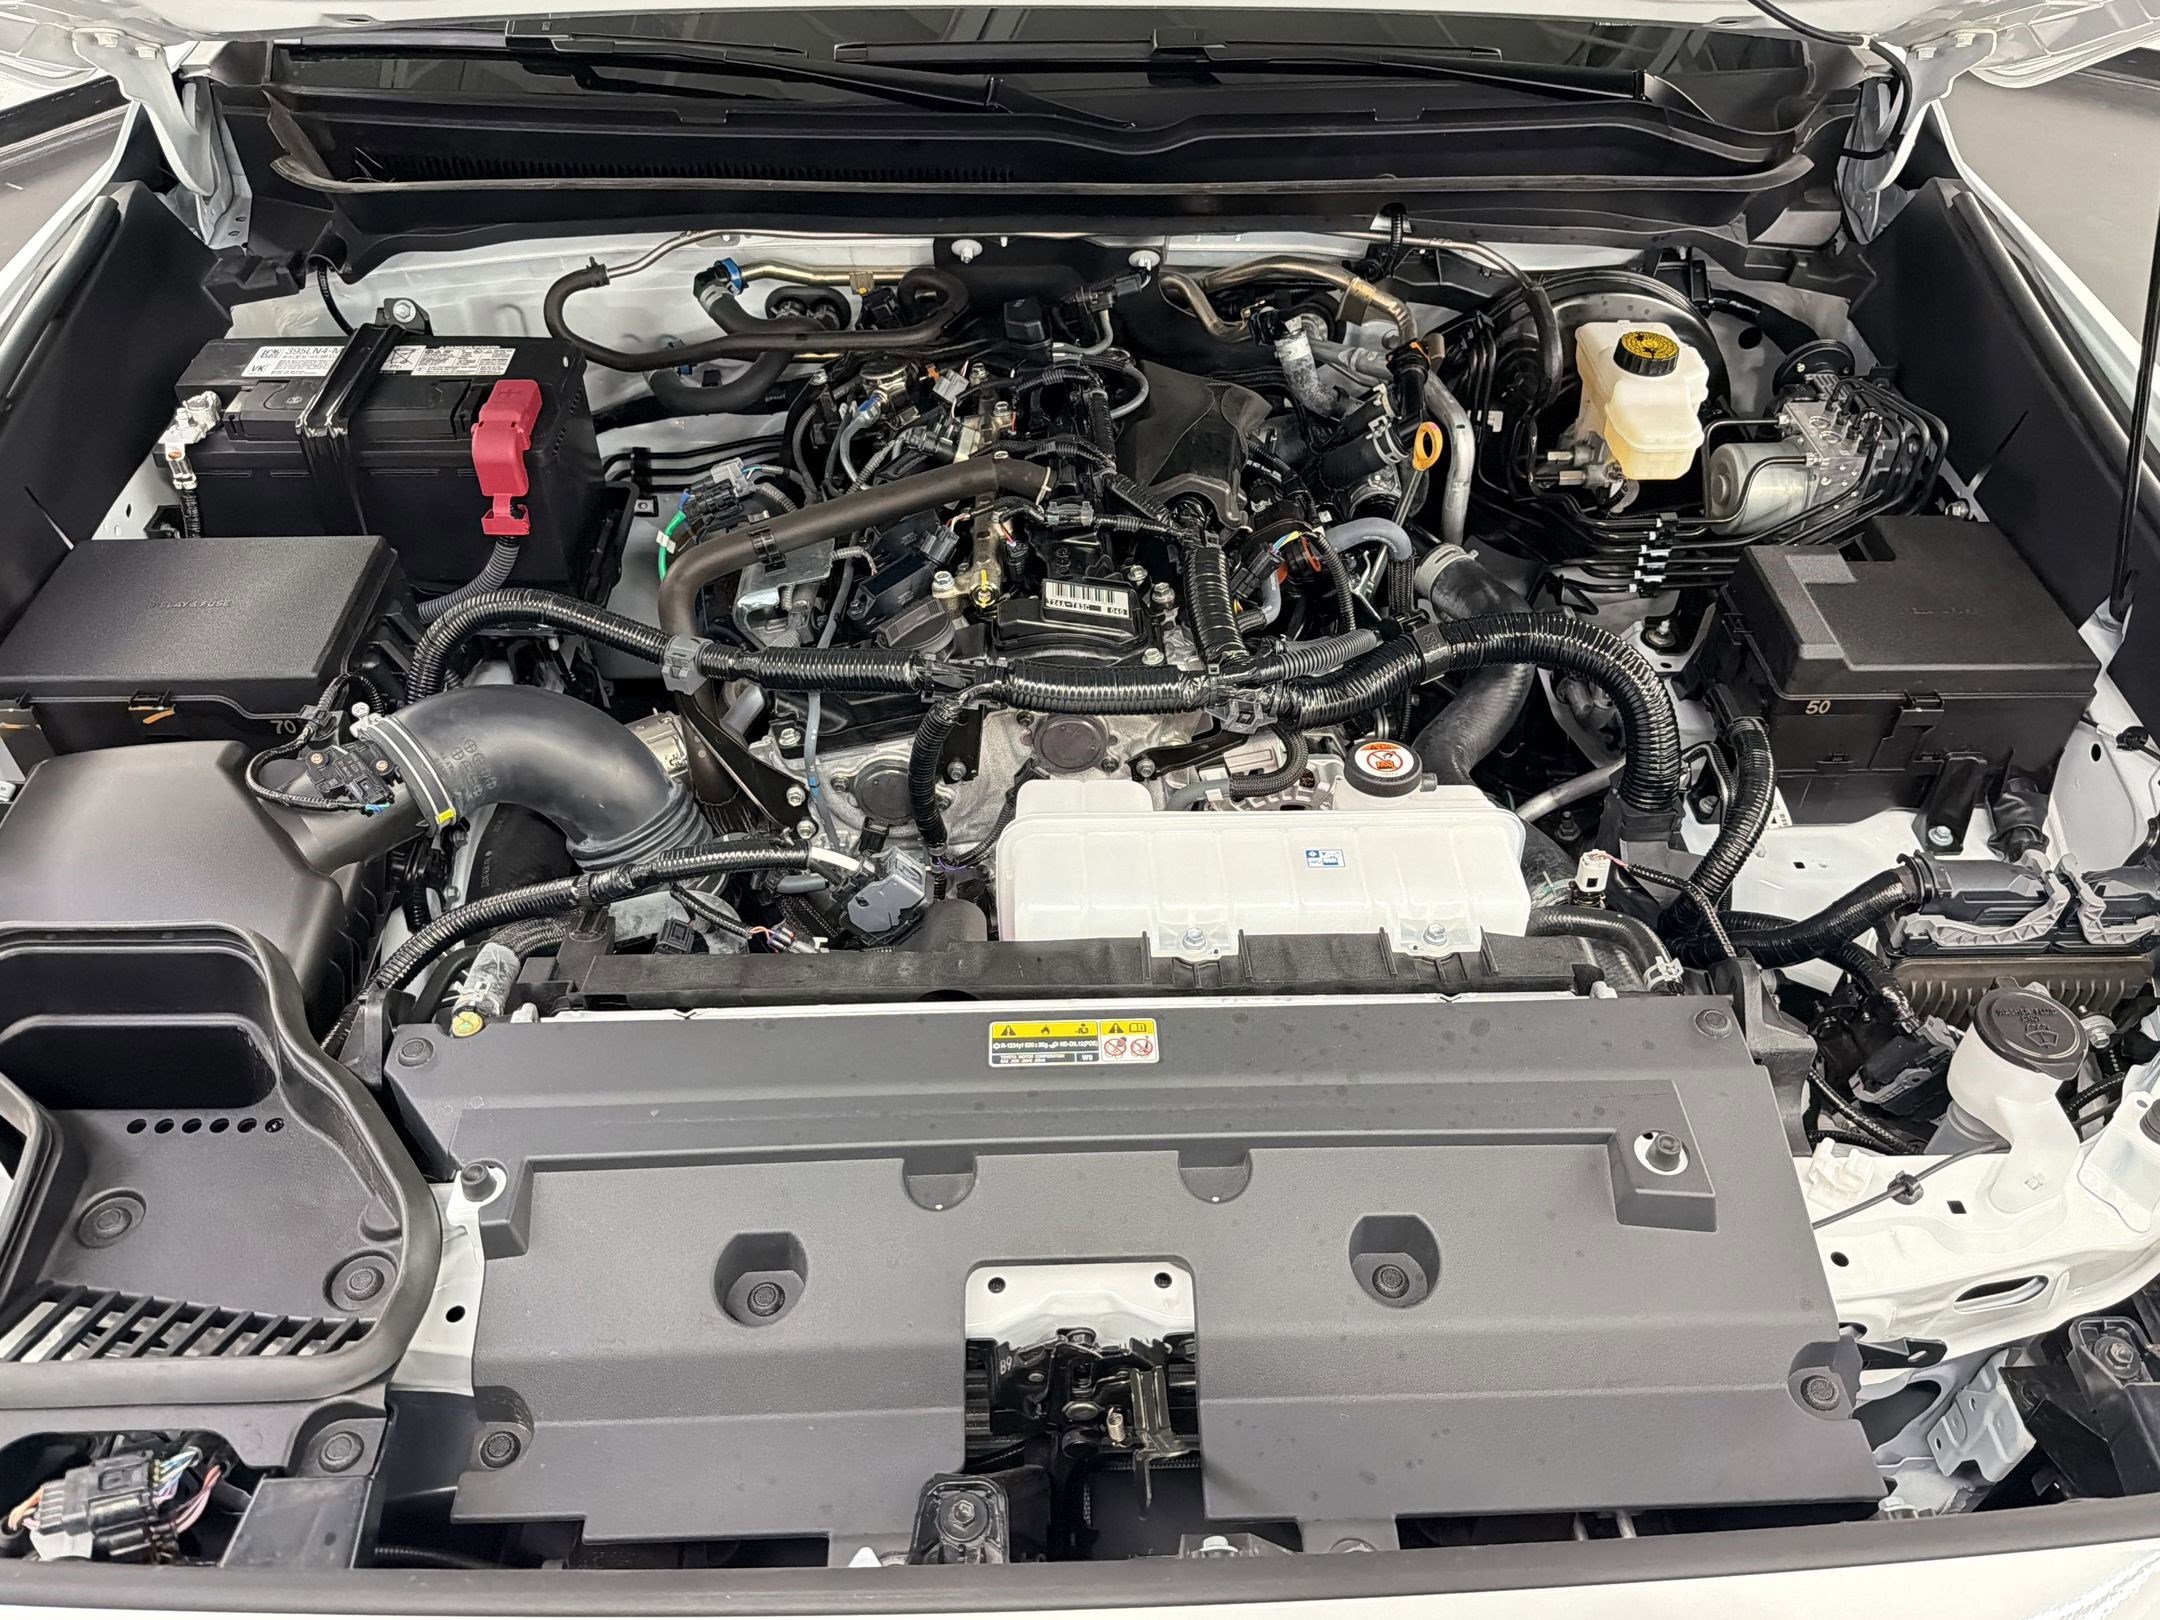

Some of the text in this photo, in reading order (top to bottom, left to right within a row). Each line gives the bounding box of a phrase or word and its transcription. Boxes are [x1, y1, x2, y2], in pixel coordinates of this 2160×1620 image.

[1805, 700, 1831, 715] 50
[270, 719, 297, 735] 70
[1000, 1355, 1012, 1375] B9
